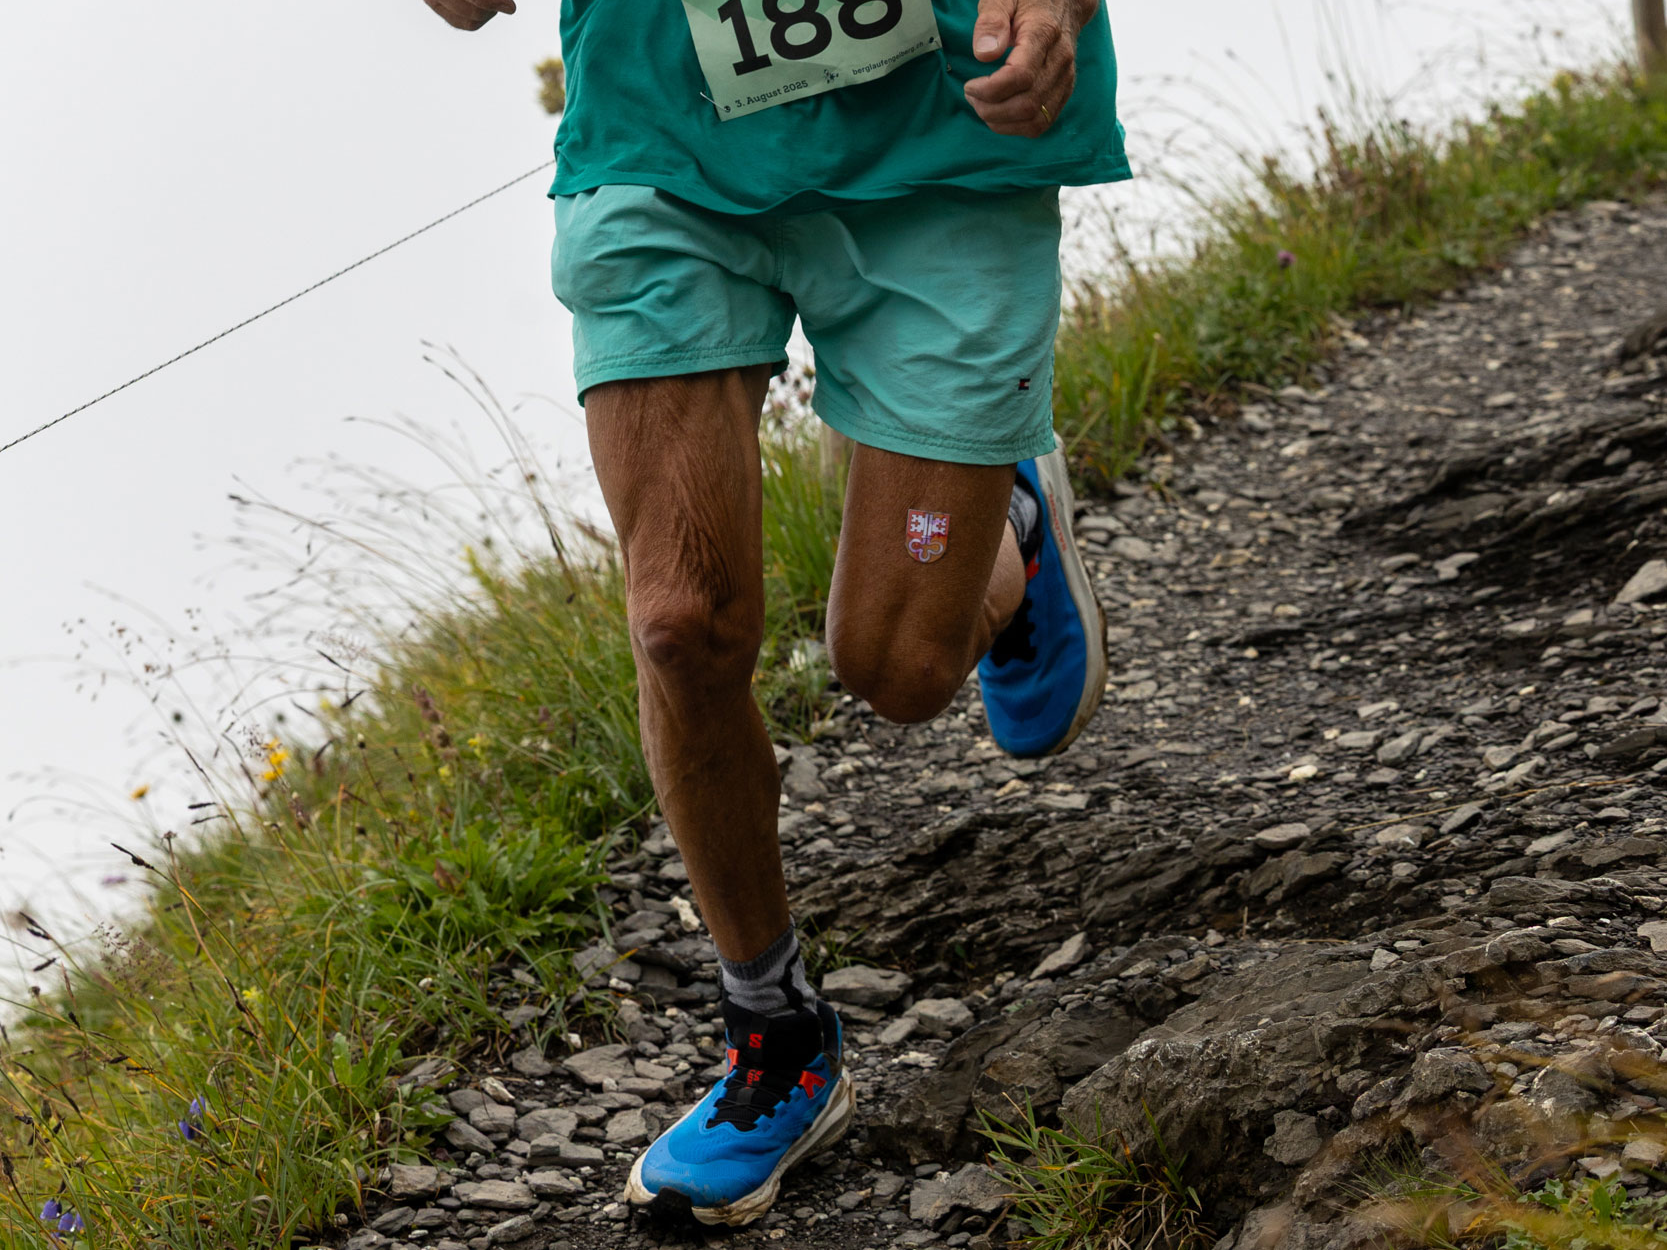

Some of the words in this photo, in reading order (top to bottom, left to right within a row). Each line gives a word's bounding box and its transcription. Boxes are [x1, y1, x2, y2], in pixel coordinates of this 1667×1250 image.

[852, 41, 925, 75] berglaufengelberg.ch
[734, 99, 746, 109] 3.
[746, 87, 782, 106] August
[782, 79, 809, 94] 2025
